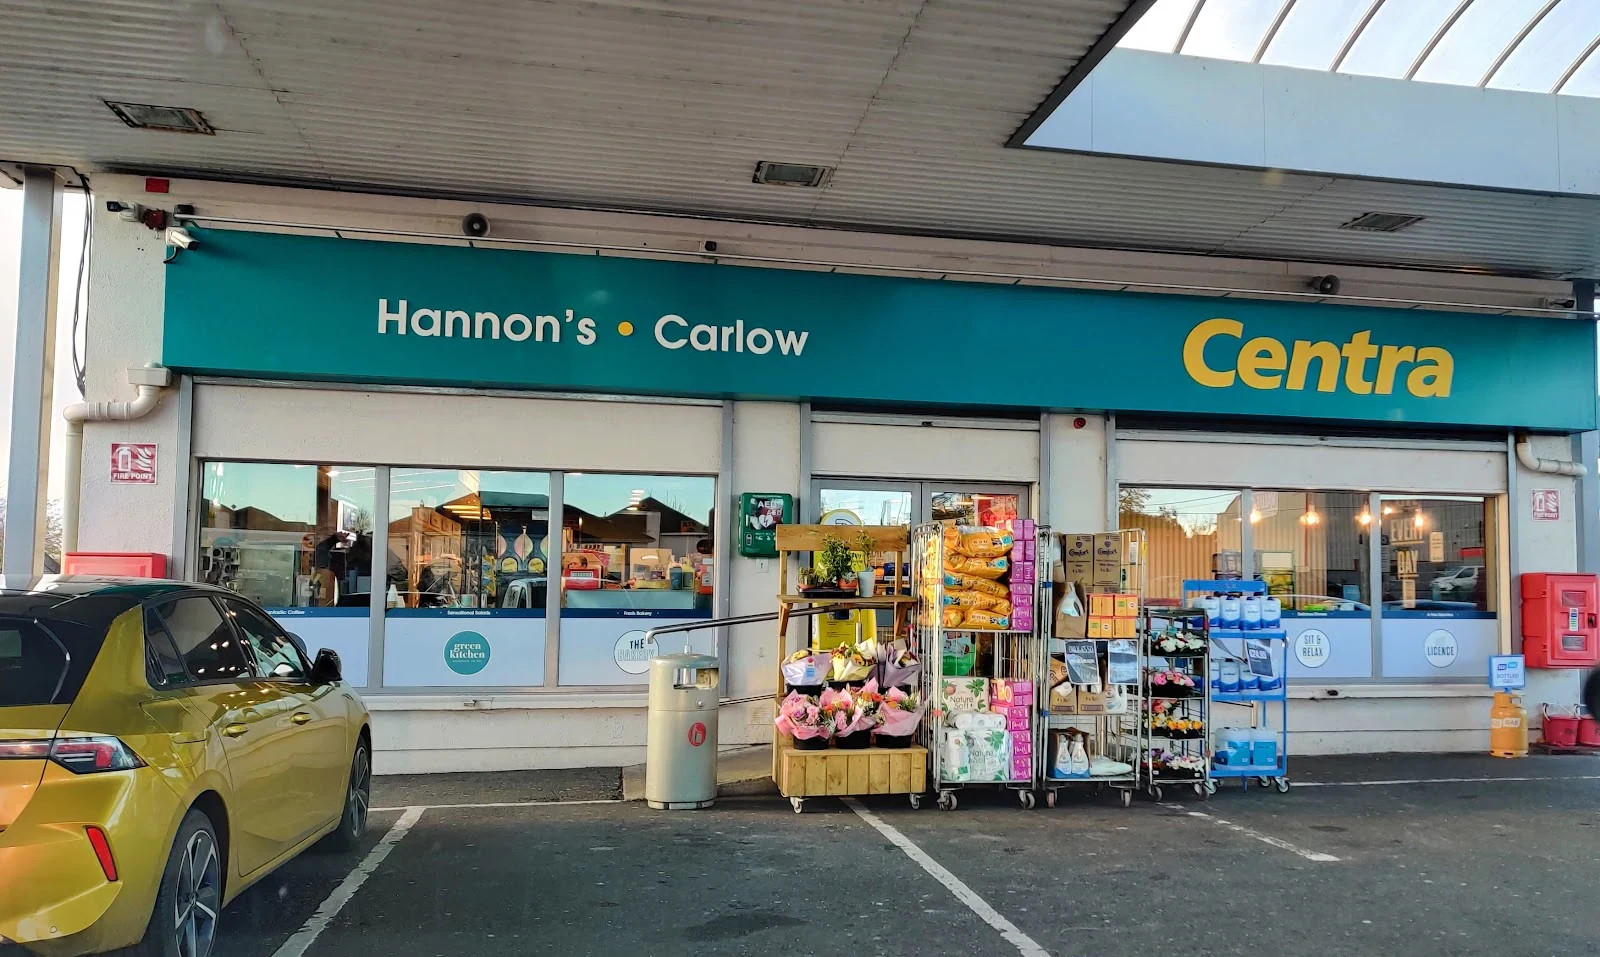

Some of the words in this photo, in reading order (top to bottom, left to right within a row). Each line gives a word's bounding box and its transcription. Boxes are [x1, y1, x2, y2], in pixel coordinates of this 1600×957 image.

[377, 298, 597, 346] Hannon's
[653, 314, 809, 356] Carlow
[1182, 317, 1454, 398] Centra
[113, 472, 129, 480] FIRE
[757, 500, 777, 508] AED
[1068, 548, 1089, 557] Comfort
[630, 638, 644, 649] THE
[1304, 634, 1315, 645] SIT
[453, 643, 481, 652] green
[1302, 647, 1323, 657] RELAX
[1427, 646, 1454, 656] LICENCE
[449, 649, 486, 659] kitchen
